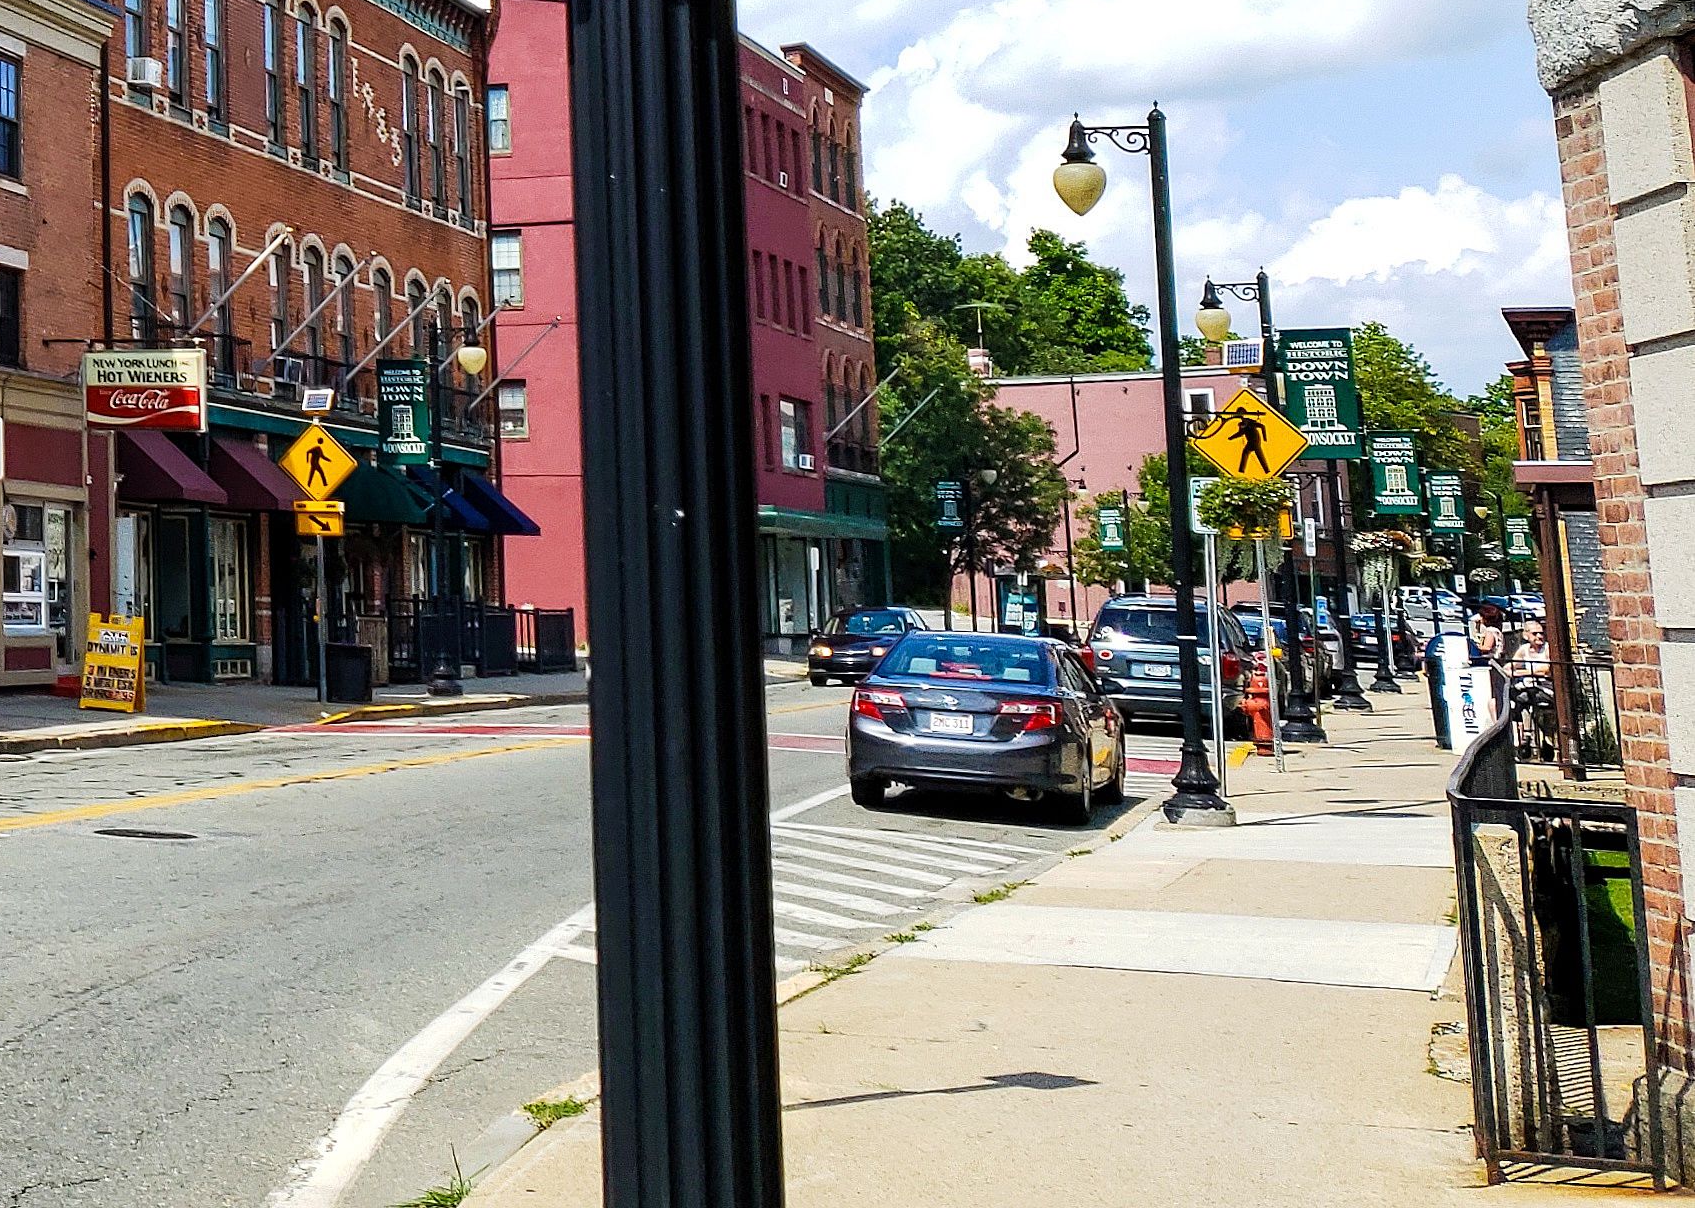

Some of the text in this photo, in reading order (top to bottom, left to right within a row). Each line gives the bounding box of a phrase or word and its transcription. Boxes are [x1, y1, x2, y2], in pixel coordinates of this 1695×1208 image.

[1288, 340, 1344, 350] WELCOME TO
[93, 358, 116, 369] NEW
[117, 358, 145, 369] YORK
[146, 358, 178, 369] LUNCH
[1286, 361, 1348, 371] DOWN
[97, 370, 187, 383] HOT WIENERS
[1286, 371, 1349, 381] TOWN
[381, 385, 425, 393] DOWN
[381, 393, 425, 402] TOWN
[1306, 432, 1357, 446] ONSOCKET
